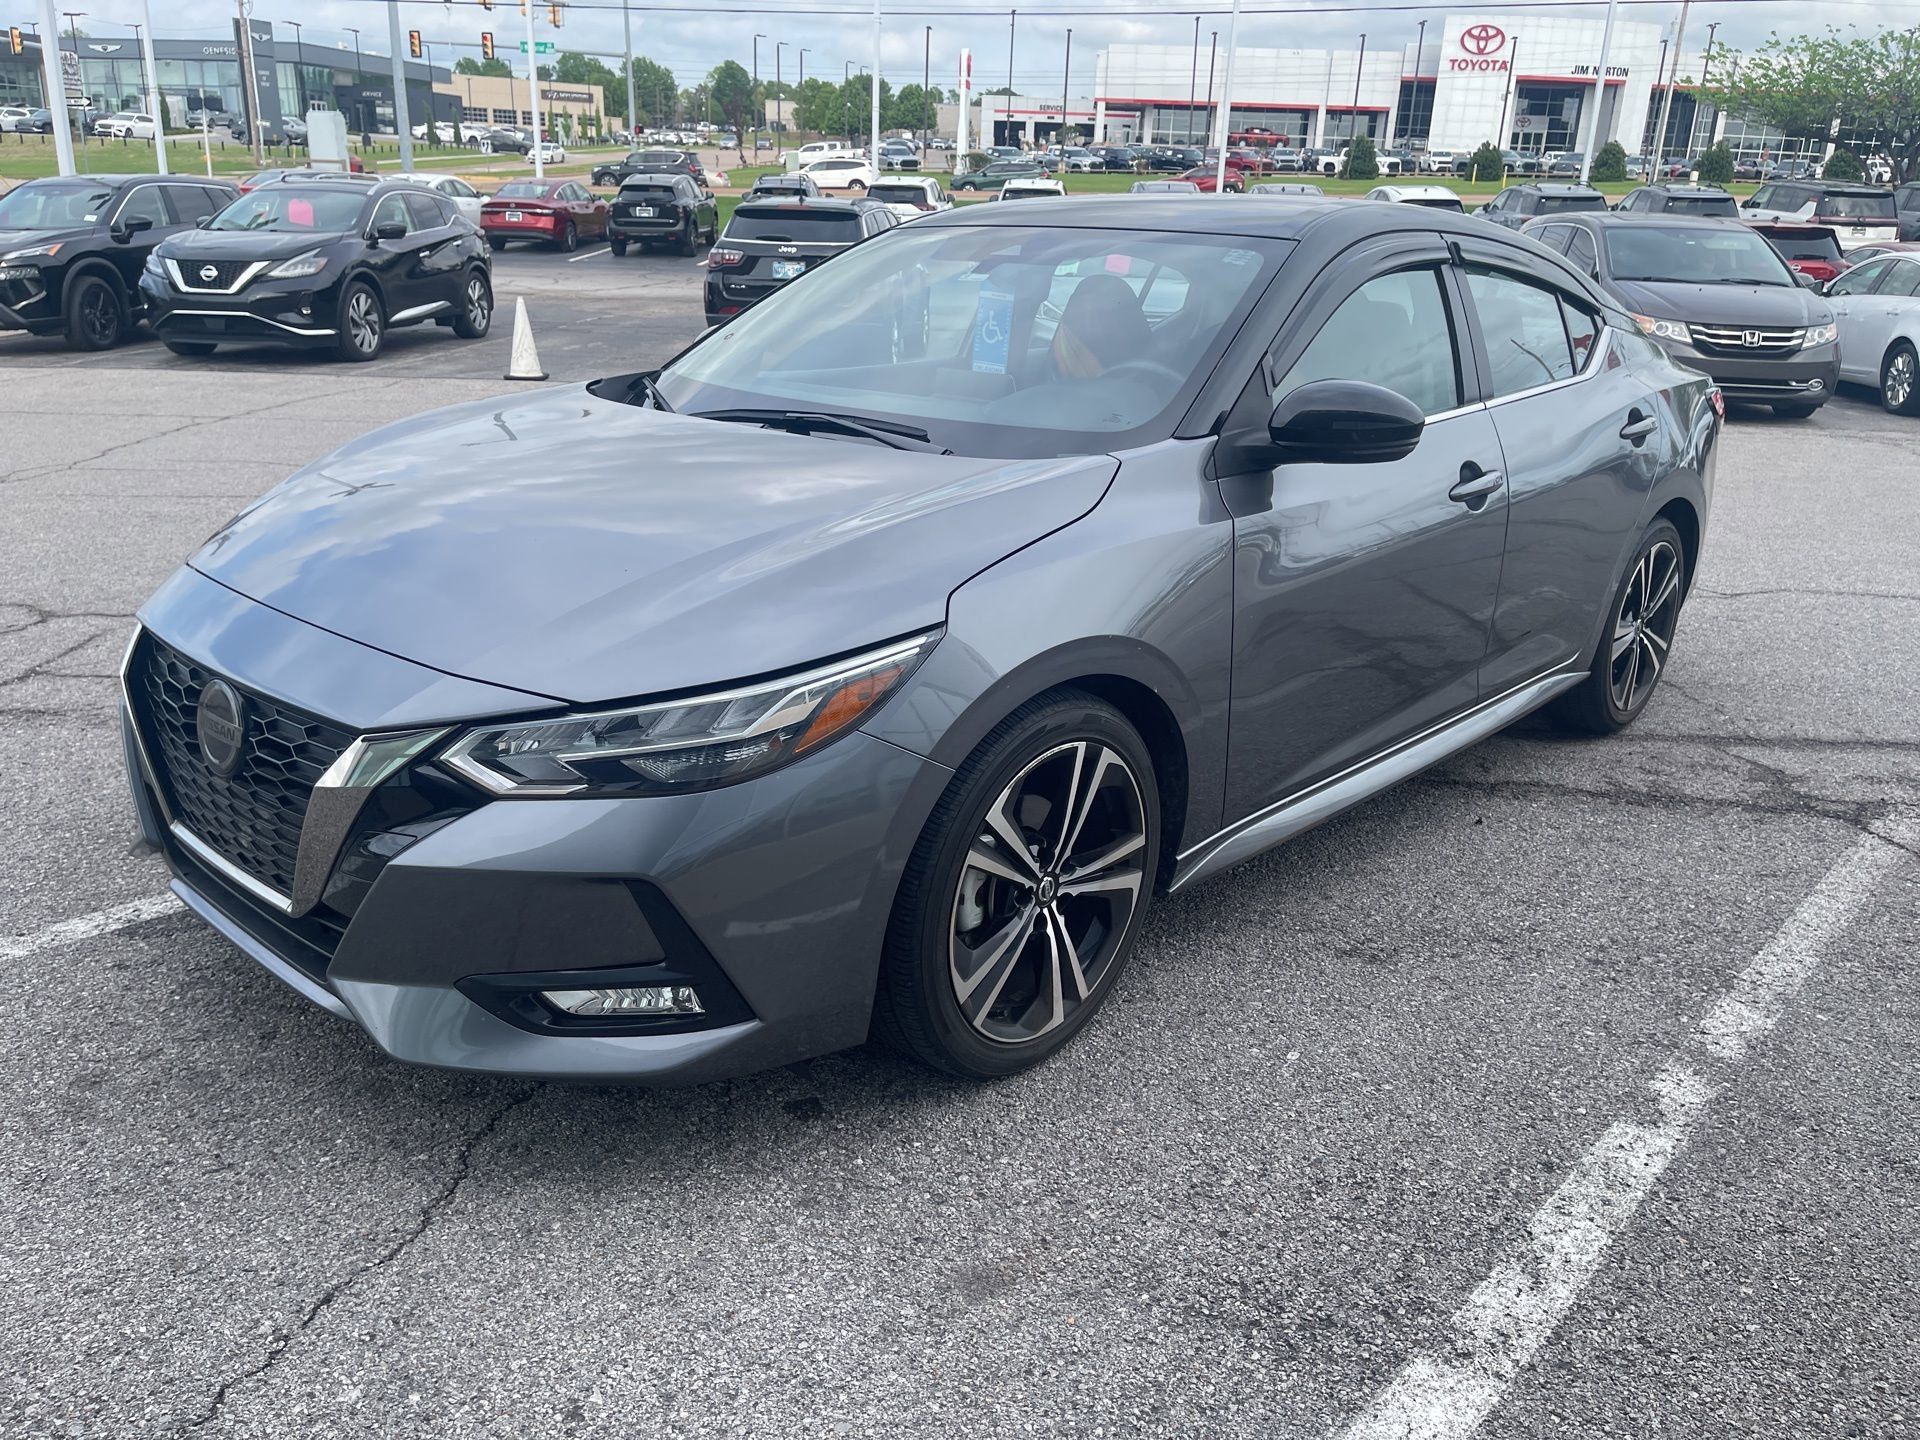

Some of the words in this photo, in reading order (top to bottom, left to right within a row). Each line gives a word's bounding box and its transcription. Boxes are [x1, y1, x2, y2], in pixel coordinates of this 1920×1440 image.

[203, 46, 236, 55] GENESIS
[1450, 58, 1508, 72] TOYOTA
[1571, 64, 1589, 76] JIM
[1592, 66, 1629, 77] NRTON
[1039, 104, 1063, 112] SERVICE
[778, 245, 797, 254] Jeep
